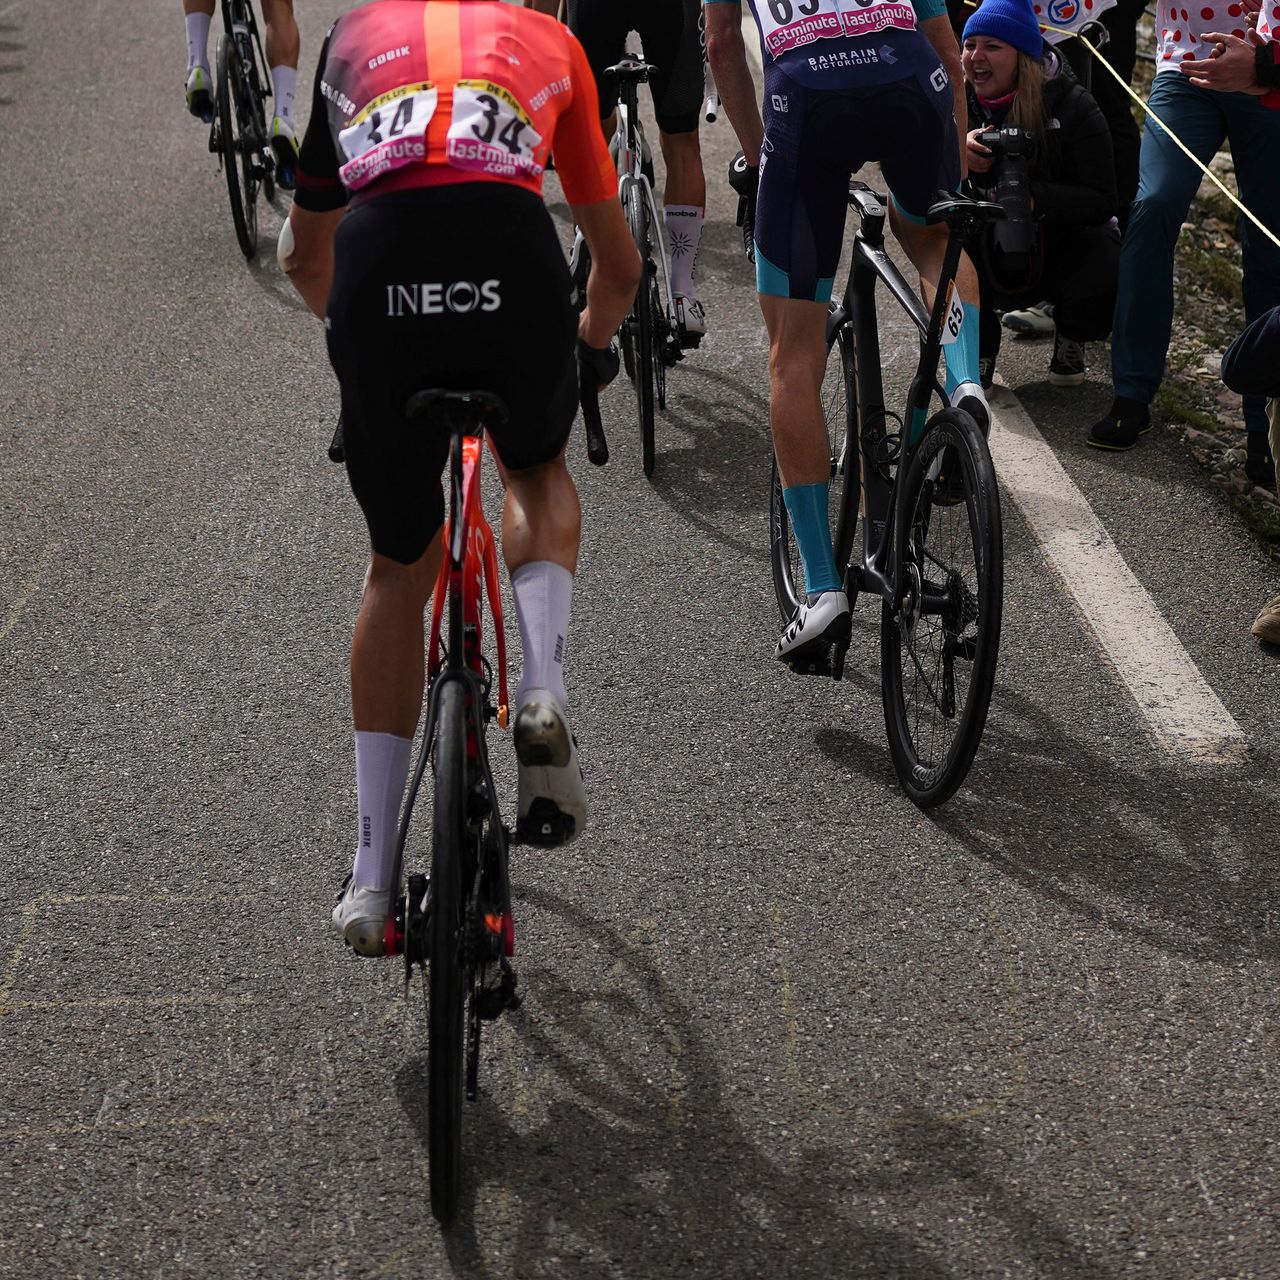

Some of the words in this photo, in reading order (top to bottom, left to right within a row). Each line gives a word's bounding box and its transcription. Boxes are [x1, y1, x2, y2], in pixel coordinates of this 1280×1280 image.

[844, 4, 914, 27] lastminute
[874, 18, 895, 30] .com
[766, 15, 838, 50] lastminute
[794, 32, 816, 46] .com
[808, 48, 877, 66] BAHRAIN
[811, 56, 879, 71] VICTORIOUS
[471, 94, 527, 154] 34
[484, 162, 517, 176] .com
[386, 278, 501, 317] INEOS
[948, 301, 963, 338] 65
